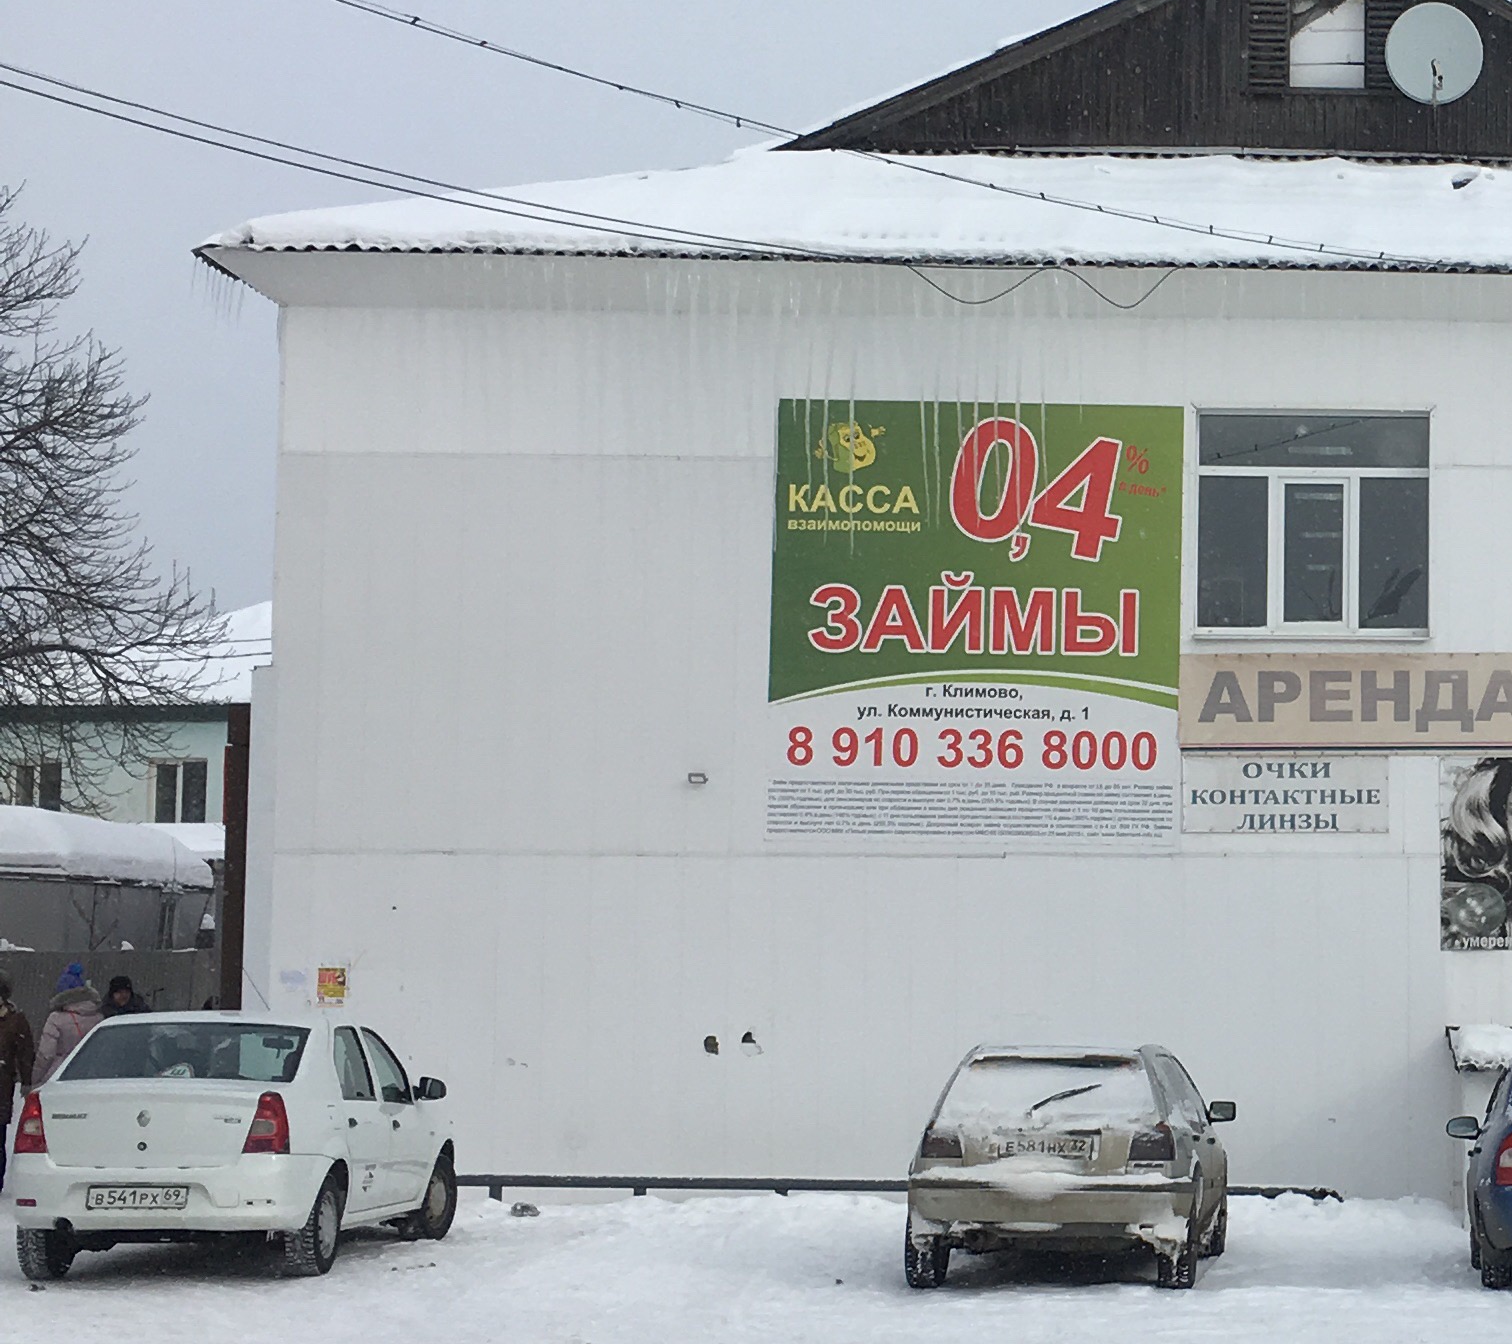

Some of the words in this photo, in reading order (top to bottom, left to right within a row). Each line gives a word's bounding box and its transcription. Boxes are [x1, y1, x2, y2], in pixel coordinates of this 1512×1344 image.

[949, 416, 1123, 562] 0,4
[788, 483, 920, 514] КАССА
[787, 518, 921, 534] взаимопомощи
[808, 570, 1140, 657] ЗАЙМЫ
[925, 687, 937, 699] г.
[942, 684, 1024, 701] Климово,
[857, 705, 882, 721] ул.
[887, 704, 1055, 722] Коммунистическая,
[1059, 708, 1076, 722] д.
[1081, 707, 1090, 721] 1
[786, 725, 814, 767] 8
[831, 726, 919, 768] 910
[936, 728, 1025, 770] 336
[1041, 730, 1158, 772] 8000
[1242, 761, 1331, 779] ОЧКИ
[1190, 788, 1381, 805] КОНТАКТНЫЕ
[1236, 813, 1339, 831] ЛИНЗЫ
[163, 1188, 181, 1202] 69
